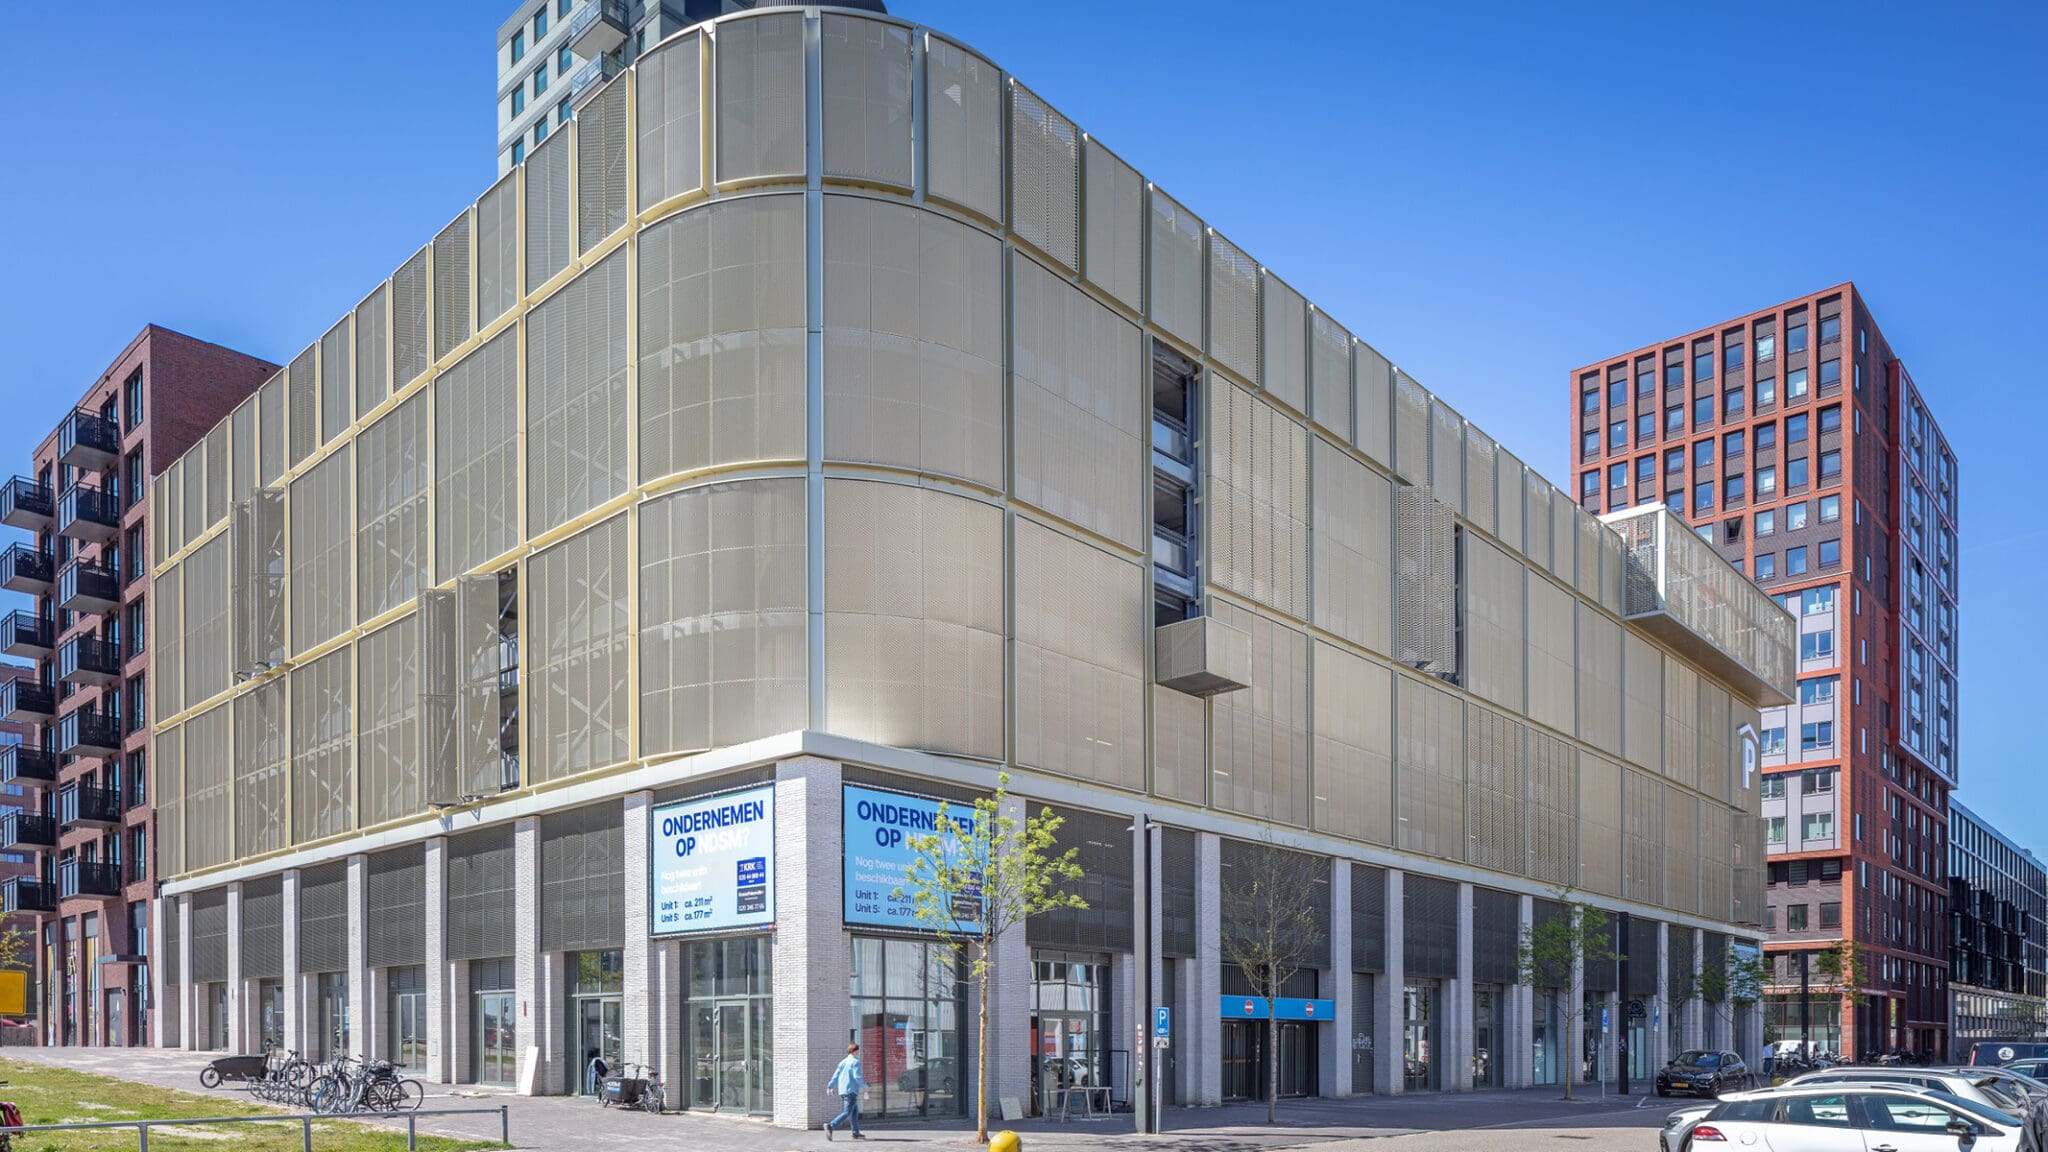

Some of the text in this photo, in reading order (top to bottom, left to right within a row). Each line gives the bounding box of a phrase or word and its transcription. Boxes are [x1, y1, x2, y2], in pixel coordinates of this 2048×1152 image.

[663, 800, 764, 837] ONDERNEMEN
[675, 827, 751, 857] OP NDSM?
[875, 827, 902, 848] OP
[855, 856, 874, 870] Nog
[875, 859, 896, 871] twee
[855, 871, 909, 887] beschikbaar
[661, 901, 673, 910] Unit
[674, 900, 679, 909] 1:
[694, 897, 704, 907] 211
[855, 890, 871, 900] Unit
[873, 891, 879, 901] 1:
[900, 894, 911, 904] 211
[661, 914, 673, 923] Unit
[674, 913, 680, 922] 5:
[684, 912, 694, 920] ca.
[694, 910, 703, 920] 177
[855, 903, 871, 913] Unit
[872, 905, 880, 913] 5:
[887, 907, 898, 915] ca.
[899, 907, 911, 916] 177
[1159, 1010, 1167, 1026] P
